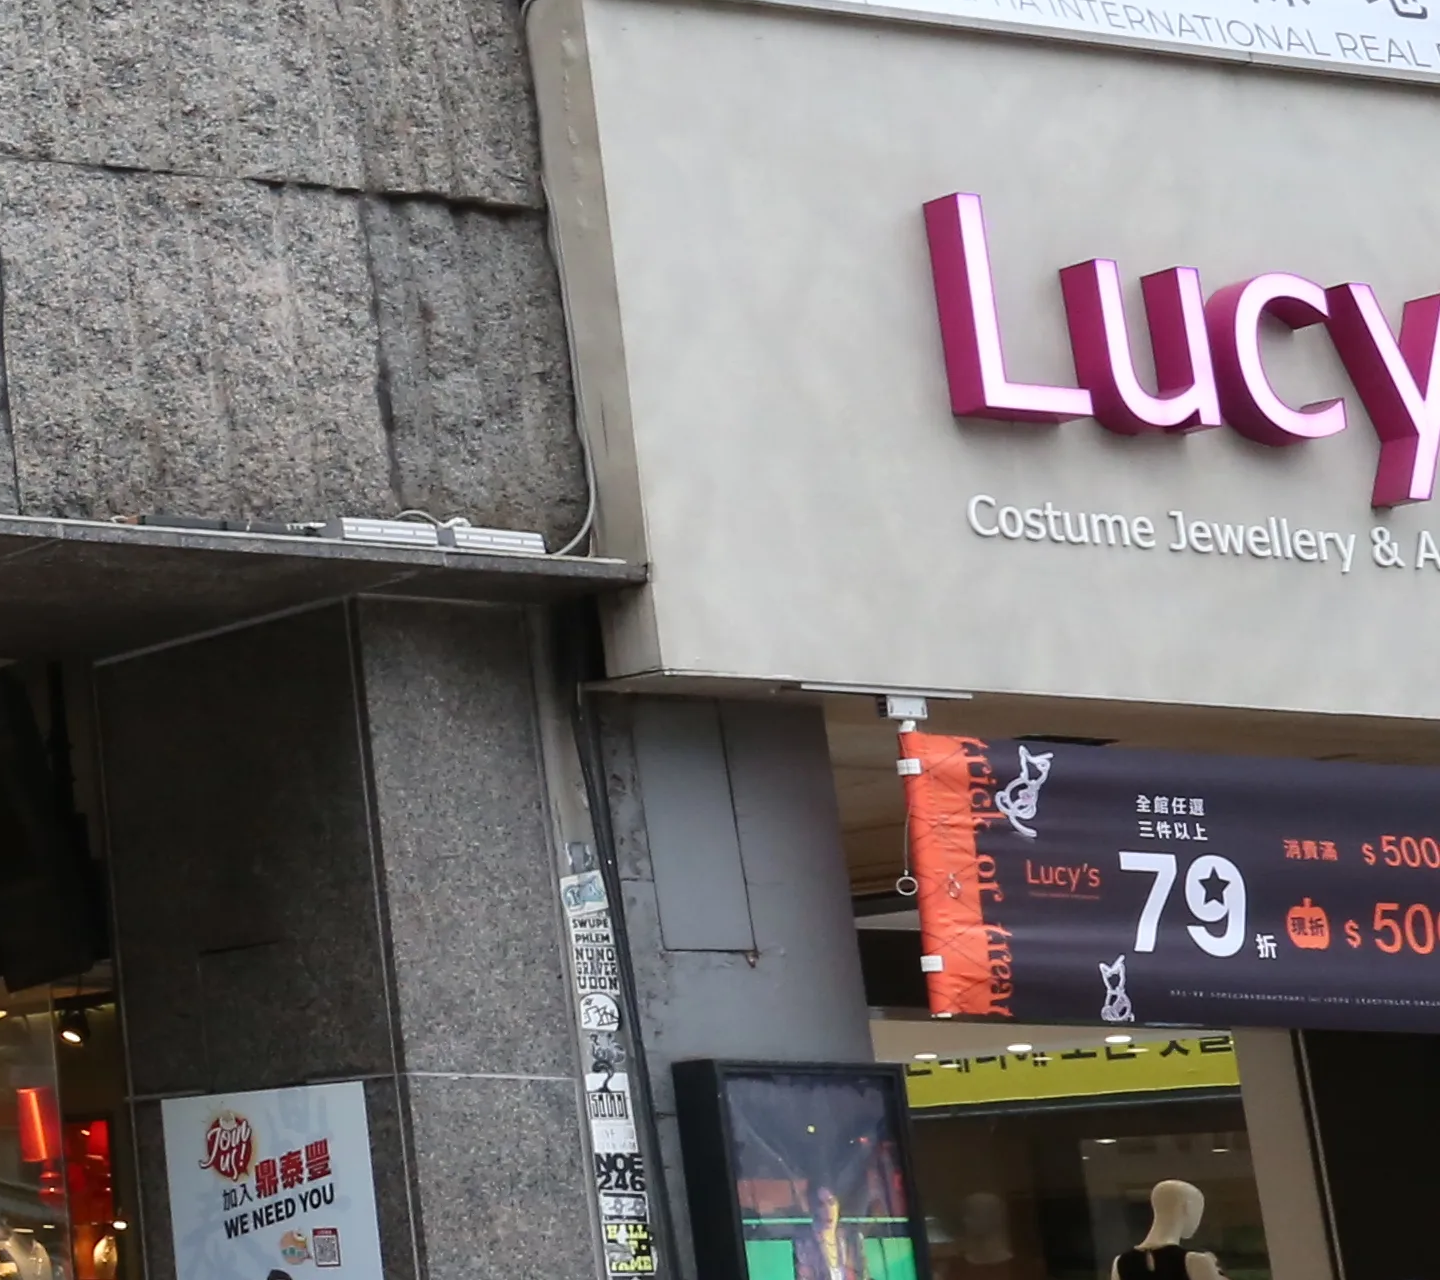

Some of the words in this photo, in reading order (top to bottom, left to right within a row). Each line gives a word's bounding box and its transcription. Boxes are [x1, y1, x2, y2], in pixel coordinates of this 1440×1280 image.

[1340, 31, 1427, 67] REAL
[967, 494, 1156, 550] Costume
[1167, 510, 1356, 573] Jewellery
[1371, 526, 1404, 569] &
[1136, 794, 1205, 817] 全館任選
[1138, 821, 1208, 842] 三件以上
[1026, 859, 1100, 890] Lucy's
[1118, 851, 1246, 958] 79
[1256, 933, 1277, 960] 折
[575, 933, 611, 943] PHLEM
[1290, 915, 1325, 938] 現折
[199, 1119, 252, 1169] Join
[219, 1142, 247, 1181] us!
[222, 1183, 254, 1210] 加入
[254, 1138, 332, 1200] 鼎泰豐
[597, 1171, 646, 1191] 246
[224, 1214, 250, 1239] WE
[252, 1198, 296, 1230] NEED
[298, 1183, 335, 1213] YOU
